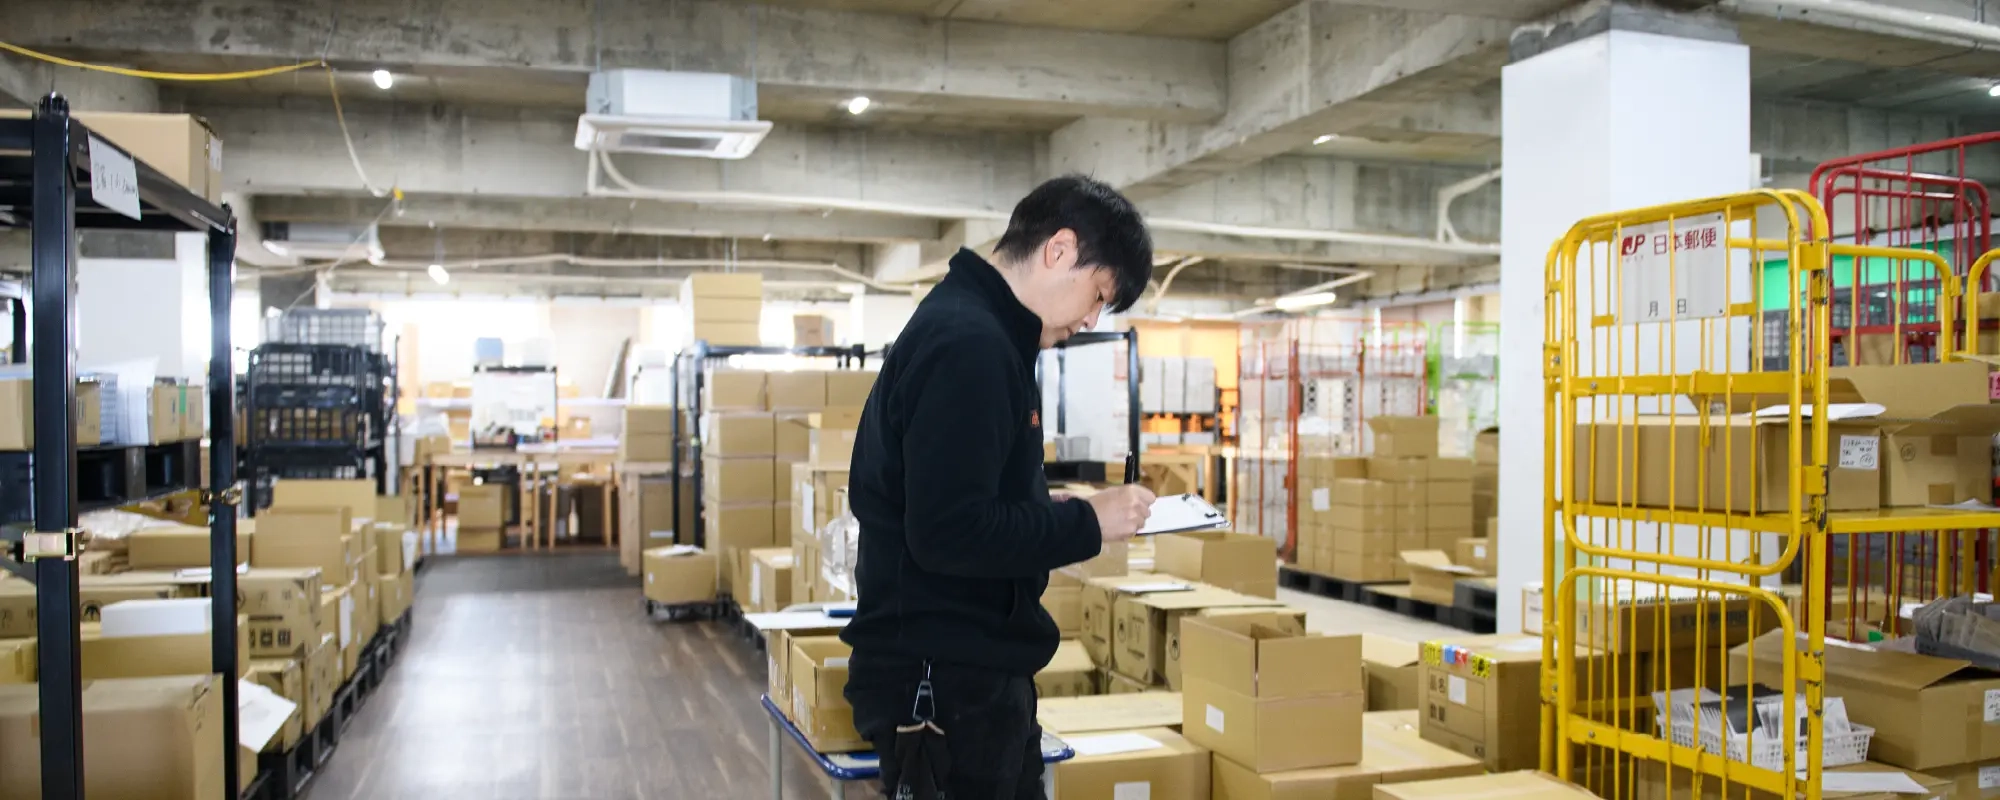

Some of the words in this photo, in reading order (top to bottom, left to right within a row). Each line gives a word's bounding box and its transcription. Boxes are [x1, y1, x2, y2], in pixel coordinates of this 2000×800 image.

[1653, 227, 1716, 255] 日本郵便
[1648, 300, 1659, 317] 月
[1676, 298, 1687, 314] 日
